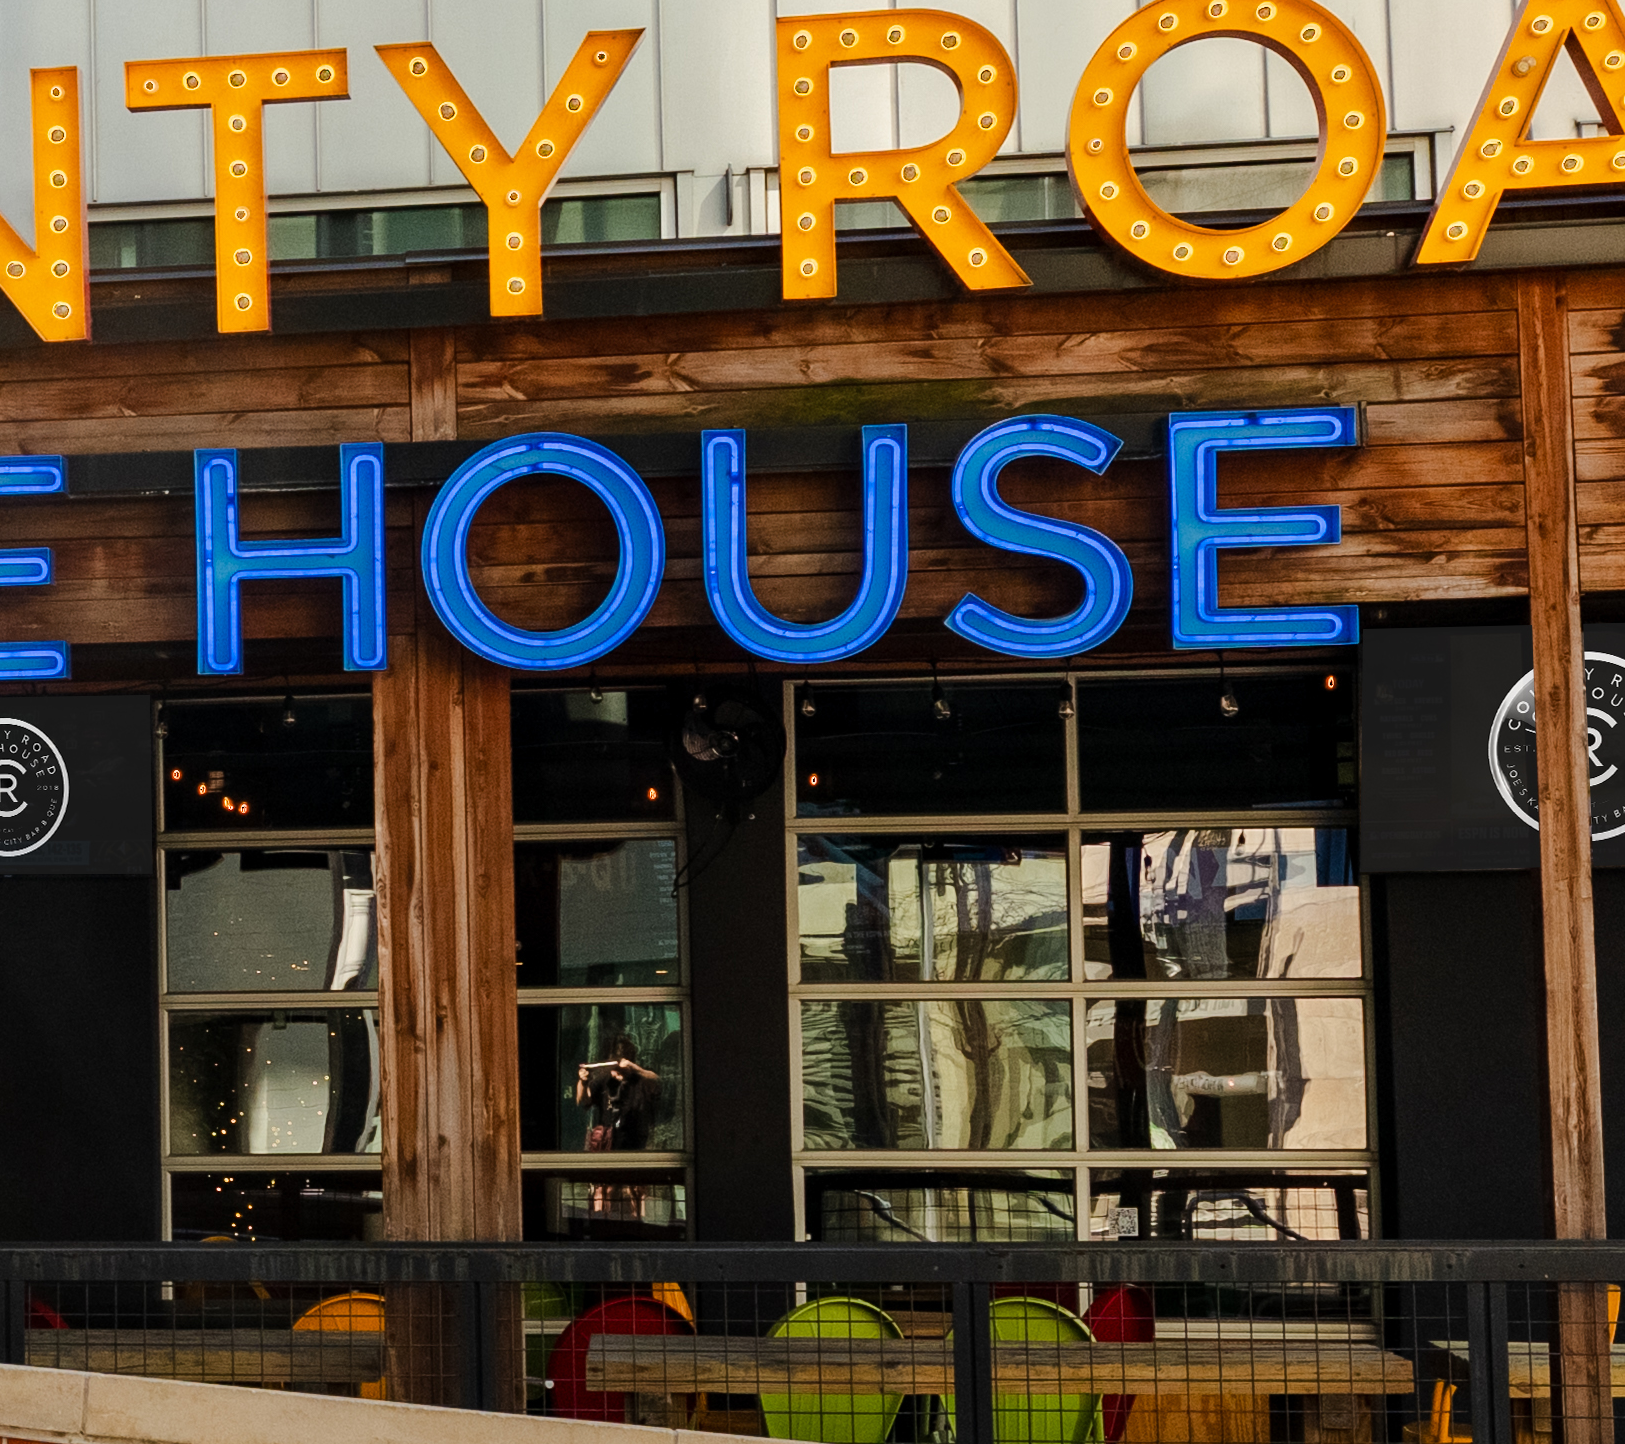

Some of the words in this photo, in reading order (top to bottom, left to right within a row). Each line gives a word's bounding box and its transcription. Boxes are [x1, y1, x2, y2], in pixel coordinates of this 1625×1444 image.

[193, 403, 1362, 675] HOUSE
[20, 734, 57, 775] ROAD
[1503, 744, 1536, 753] EST.
